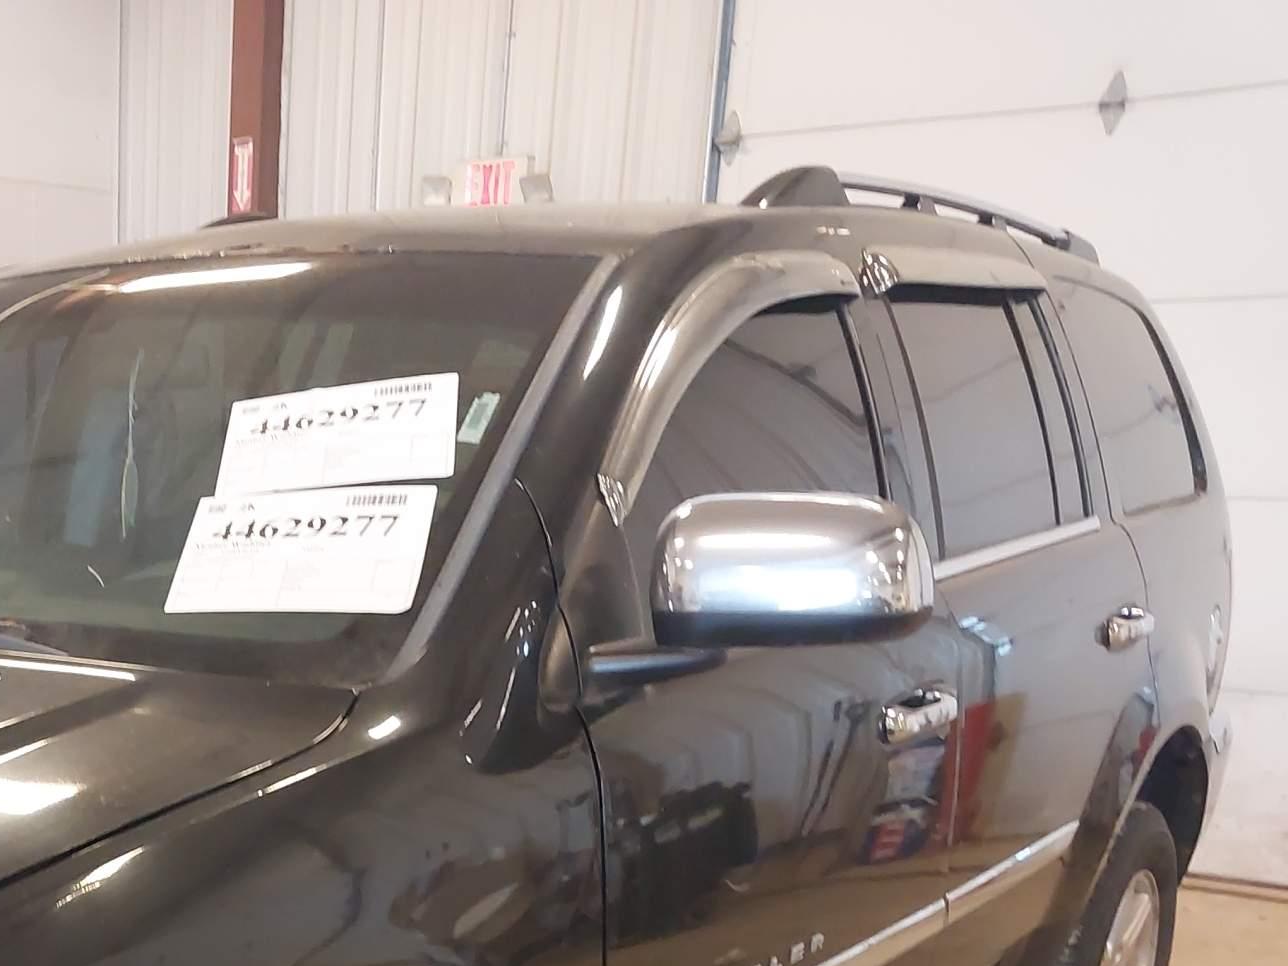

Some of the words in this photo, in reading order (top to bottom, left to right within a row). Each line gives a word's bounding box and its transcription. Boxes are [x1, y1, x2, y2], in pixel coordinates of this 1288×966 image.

[467, 161, 515, 206] EXIT
[250, 398, 428, 434] 44629277
[212, 514, 399, 540] 44629277
